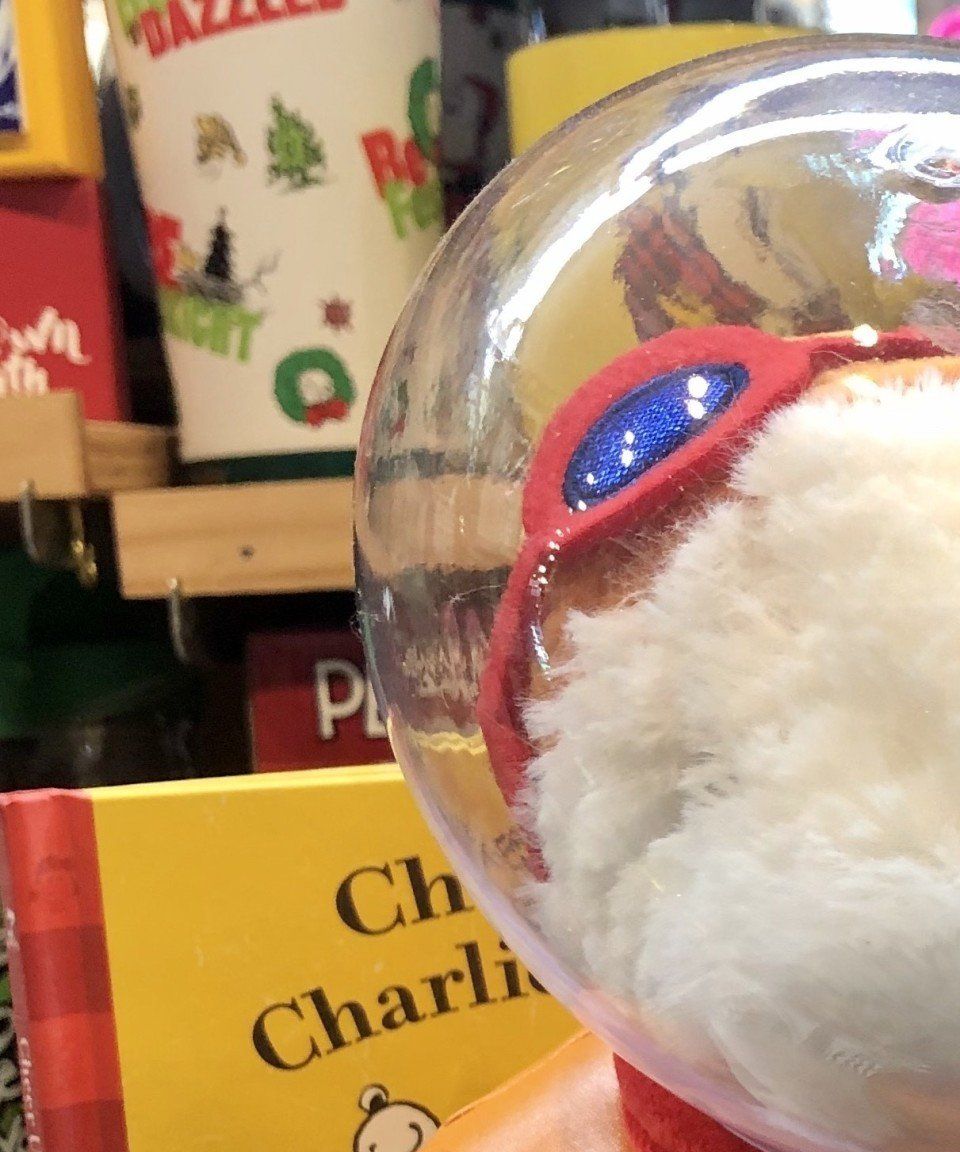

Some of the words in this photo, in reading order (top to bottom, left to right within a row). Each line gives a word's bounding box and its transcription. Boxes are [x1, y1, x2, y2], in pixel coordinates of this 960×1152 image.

[139, 0, 347, 58] DAZZL
[251, 939, 552, 1071] Charli
[18, 1037, 36, 1128] Cheer
